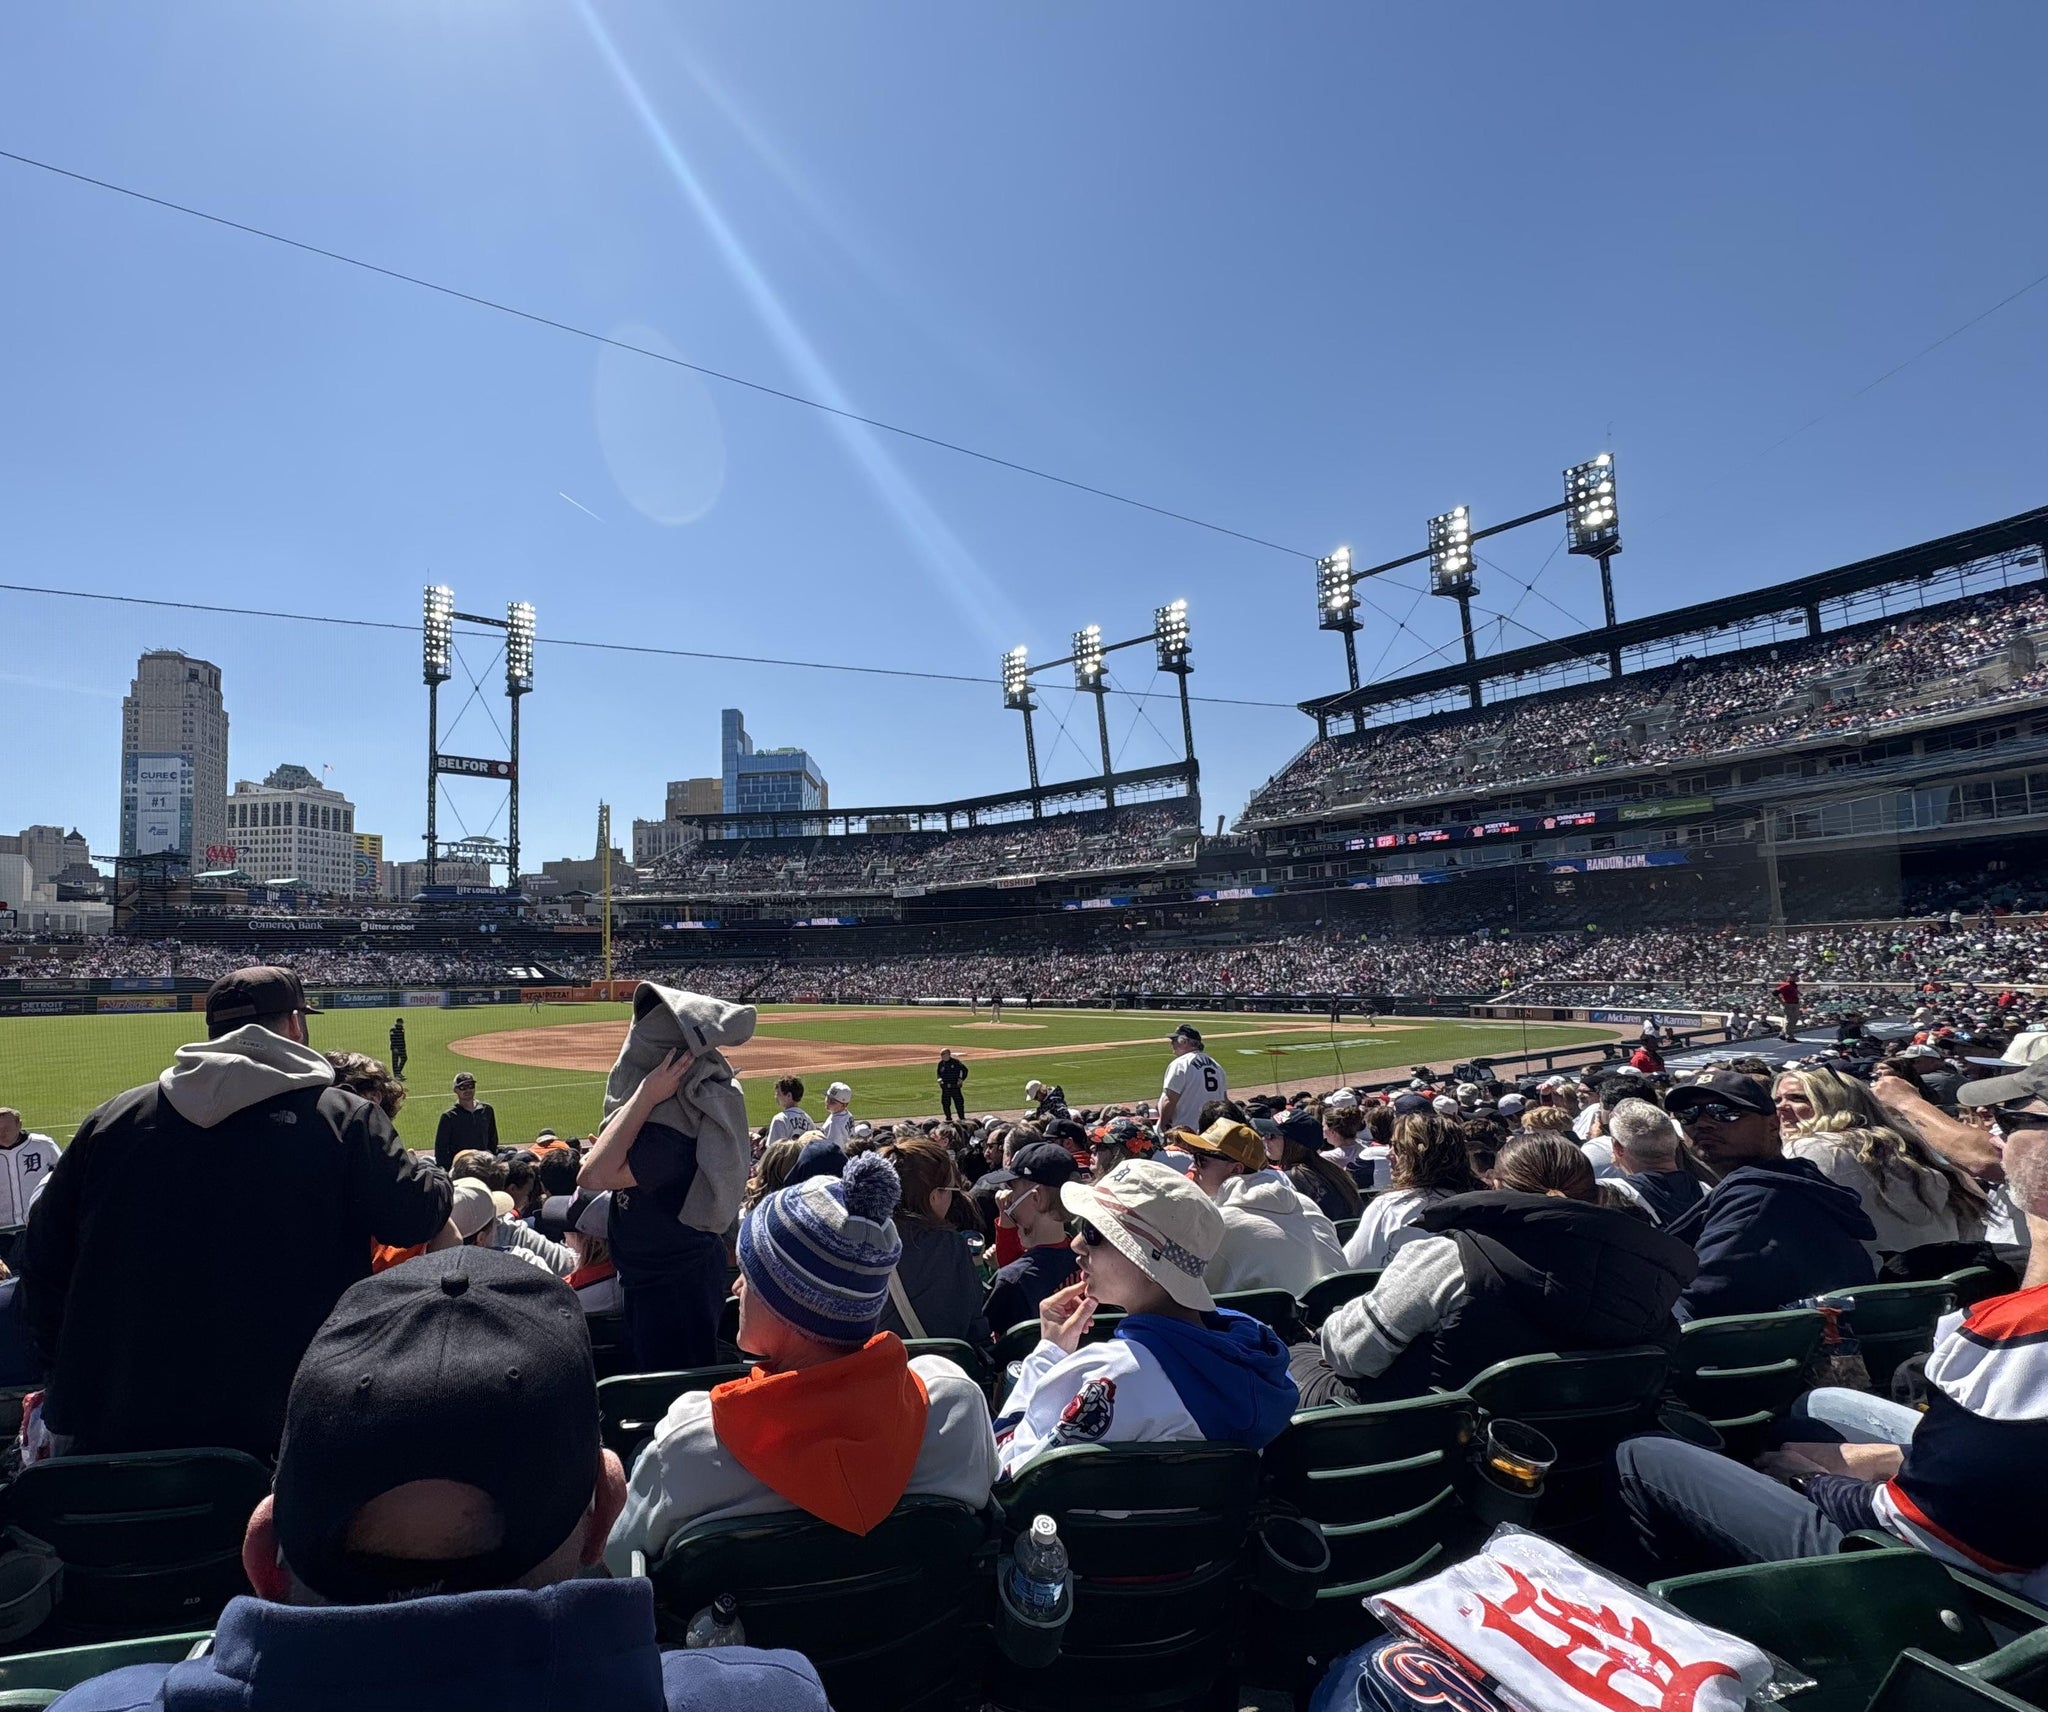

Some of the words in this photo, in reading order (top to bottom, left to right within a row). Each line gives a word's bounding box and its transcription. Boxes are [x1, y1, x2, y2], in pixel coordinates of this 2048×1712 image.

[437, 757, 488, 773] BELFOR
[141, 771, 168, 779] CURE
[151, 796, 165, 807] #1
[1557, 812, 1596, 821] DINGLER
[1586, 855, 1624, 871] RANDOM
[1624, 854, 1646, 868] CAM
[998, 877, 1035, 888] TOSHIBA
[298, 920, 324, 930] Bank
[49, 947, 58, 955] 42
[411, 992, 440, 1004] meijer
[1607, 1013, 1641, 1024] McLaren
[1663, 1016, 1701, 1026] Karmanos
[1203, 1067, 1218, 1092] 6
[789, 1116, 811, 1132] CASEY
[22, 1152, 42, 1176] D
